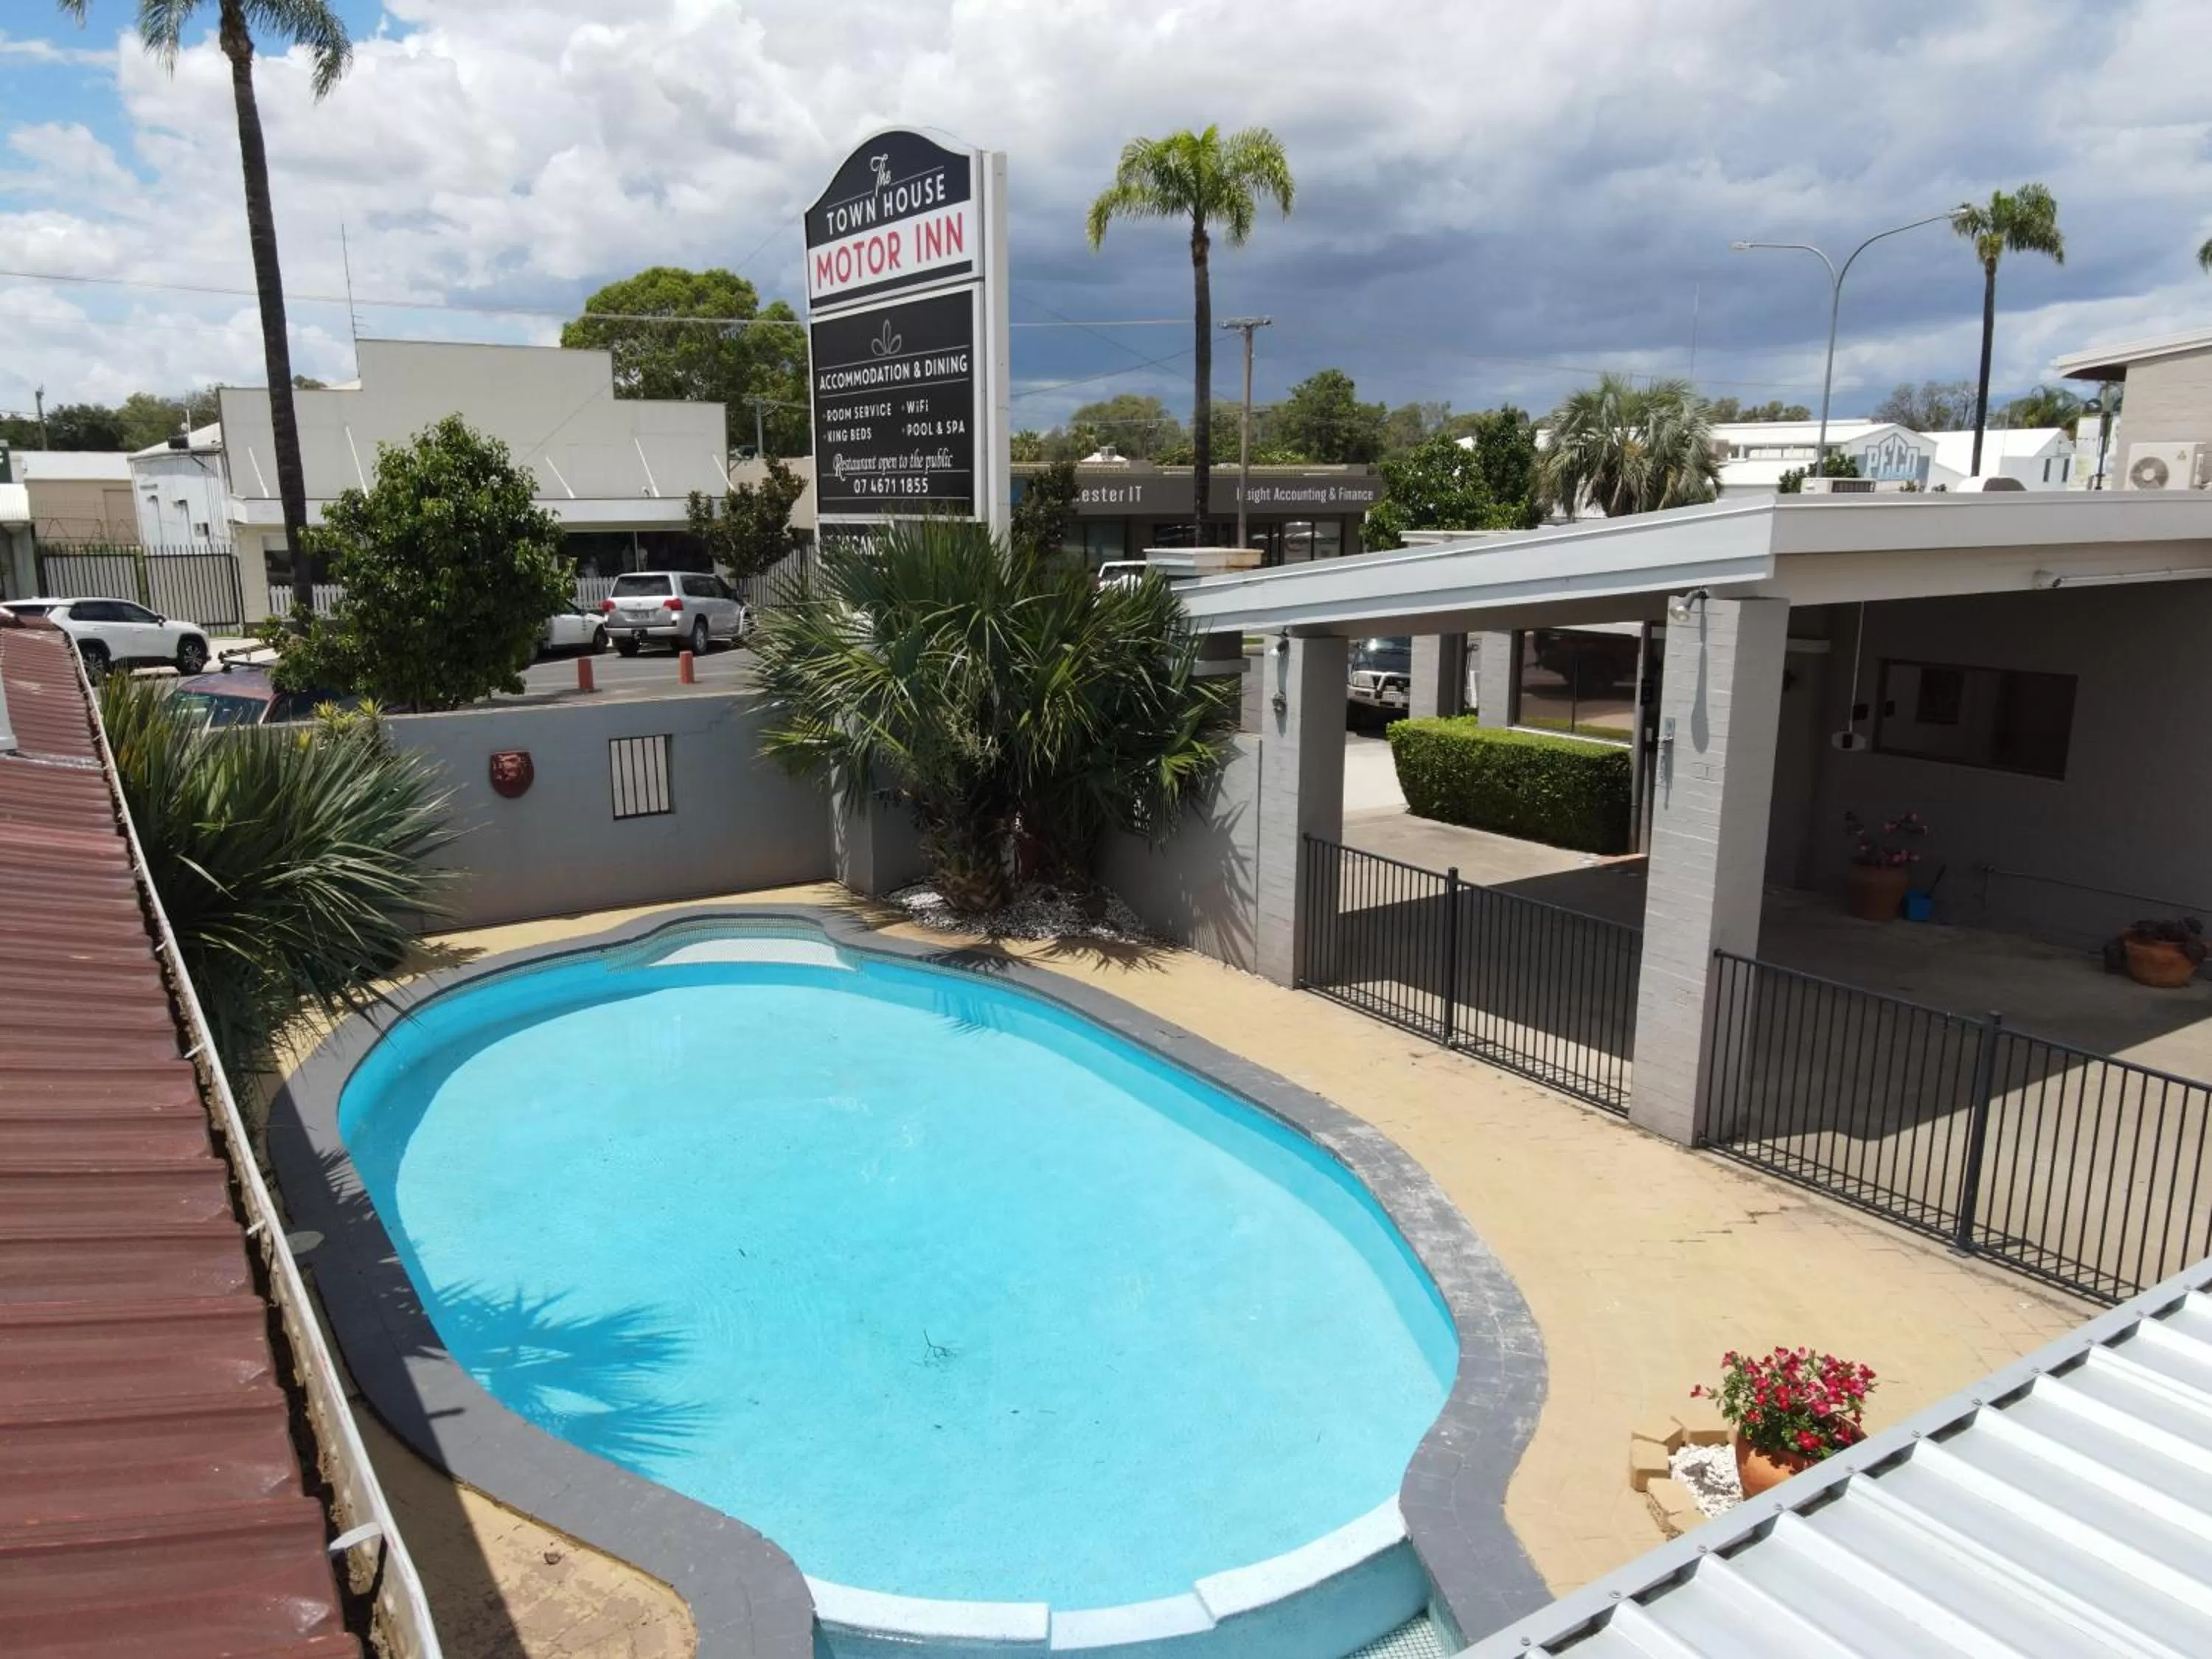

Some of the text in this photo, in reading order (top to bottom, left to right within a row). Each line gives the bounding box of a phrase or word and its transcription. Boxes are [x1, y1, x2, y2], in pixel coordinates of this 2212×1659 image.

[870, 153, 891, 197] The
[827, 173, 946, 235] TOWN HOUSE
[816, 212, 964, 289] MOTOR INN
[819, 354, 968, 390] ACCOMMODATION & DINING
[827, 403, 892, 422] ROOM SERVICE
[827, 427, 872, 442] KING BEDS
[907, 422, 933, 437] POOL
[946, 419, 965, 434] SPA
[878, 455, 897, 476] open
[899, 454, 908, 469] to
[909, 448, 923, 469] the
[854, 478, 929, 494] 07 4671 1855
[1129, 485, 1142, 503] IT
[1237, 487, 1374, 503] Isight Accounting & Finance
